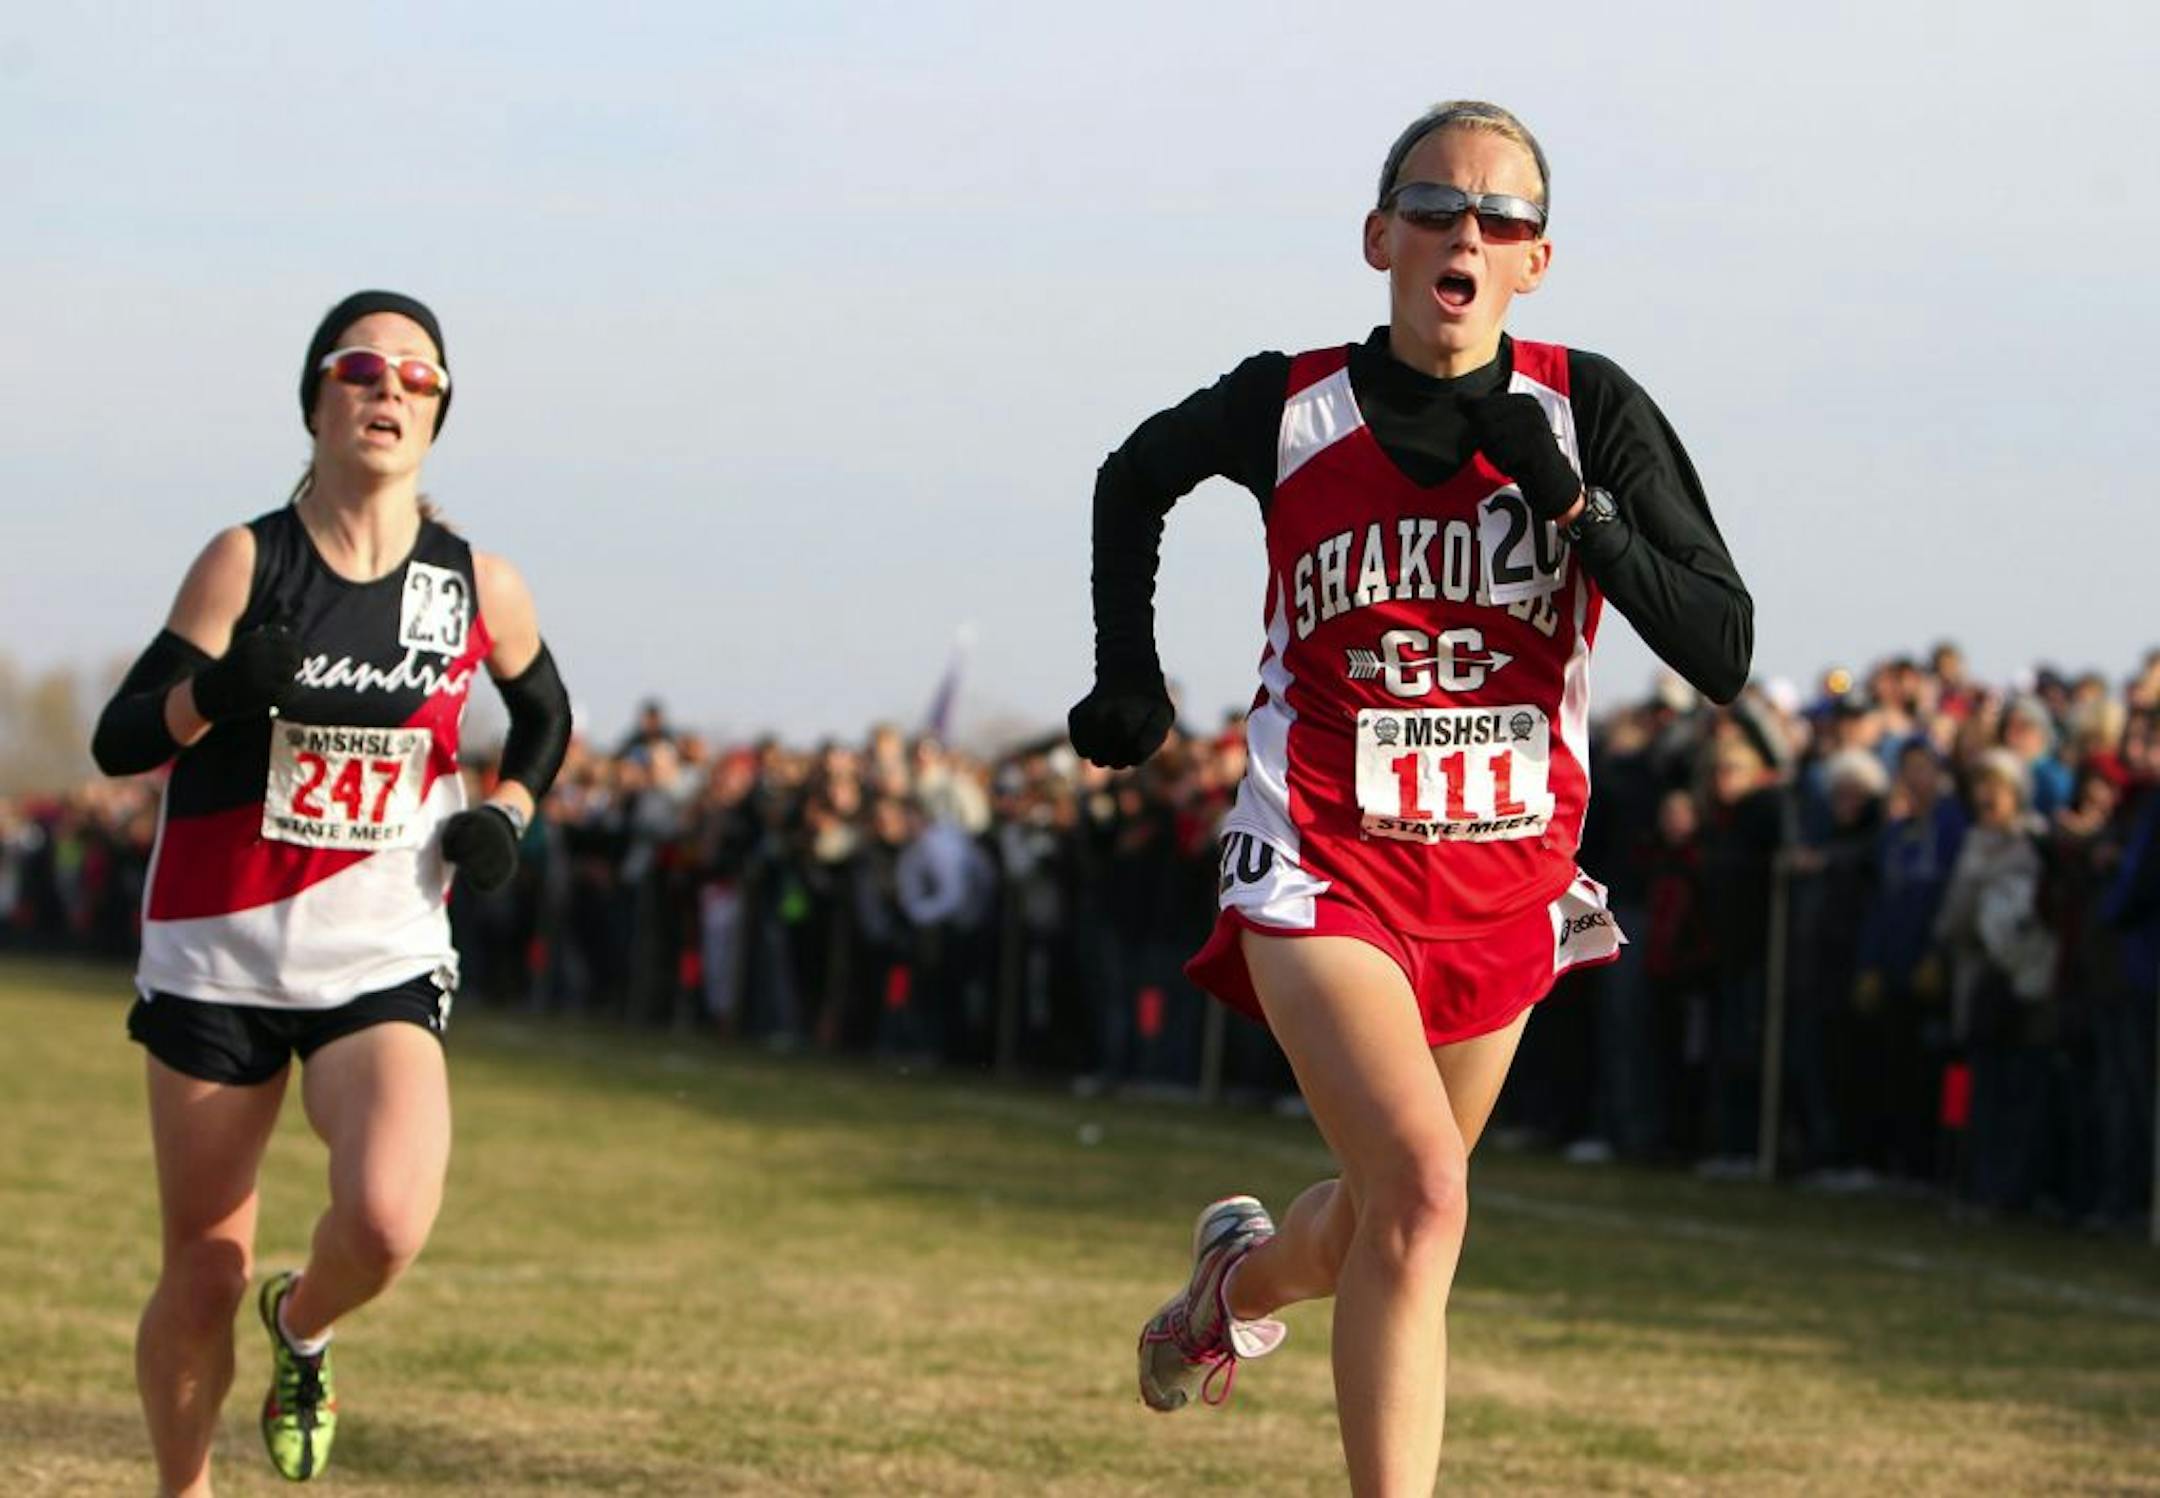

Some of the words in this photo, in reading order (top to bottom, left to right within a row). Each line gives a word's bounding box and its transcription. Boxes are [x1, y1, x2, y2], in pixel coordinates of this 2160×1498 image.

[1484, 494, 1564, 584] 20
[406, 571, 467, 646] 23
[1294, 518, 1559, 640] SHAKO
[294, 648, 473, 695] xandria
[1380, 628, 1486, 696] CC
[309, 732, 394, 756] MSHSL
[1404, 715, 1507, 747] MSHSL
[291, 751, 403, 824] 247
[1392, 749, 1526, 820] 111
[1377, 818, 1460, 836] STATE
[1467, 814, 1540, 834] MEET
